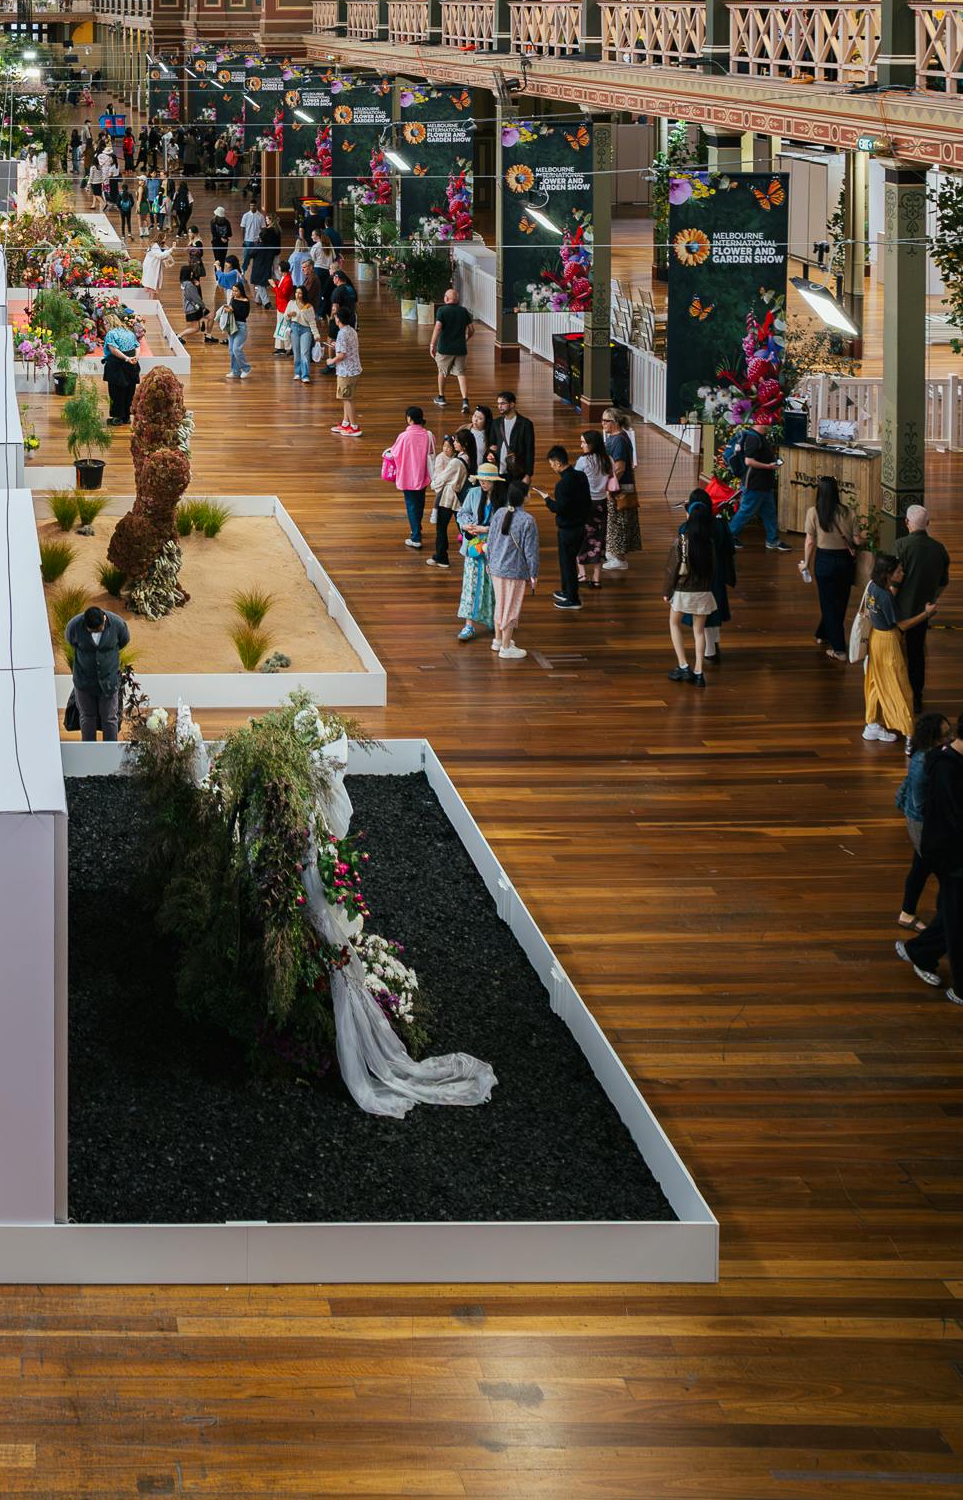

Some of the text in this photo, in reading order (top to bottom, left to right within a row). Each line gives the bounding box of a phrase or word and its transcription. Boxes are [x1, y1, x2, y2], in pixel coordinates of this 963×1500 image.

[712, 232, 764, 240] MELBOURNE
[712, 247, 776, 255] FLOWER AND
[712, 255, 784, 264] GARDEN SHOW
